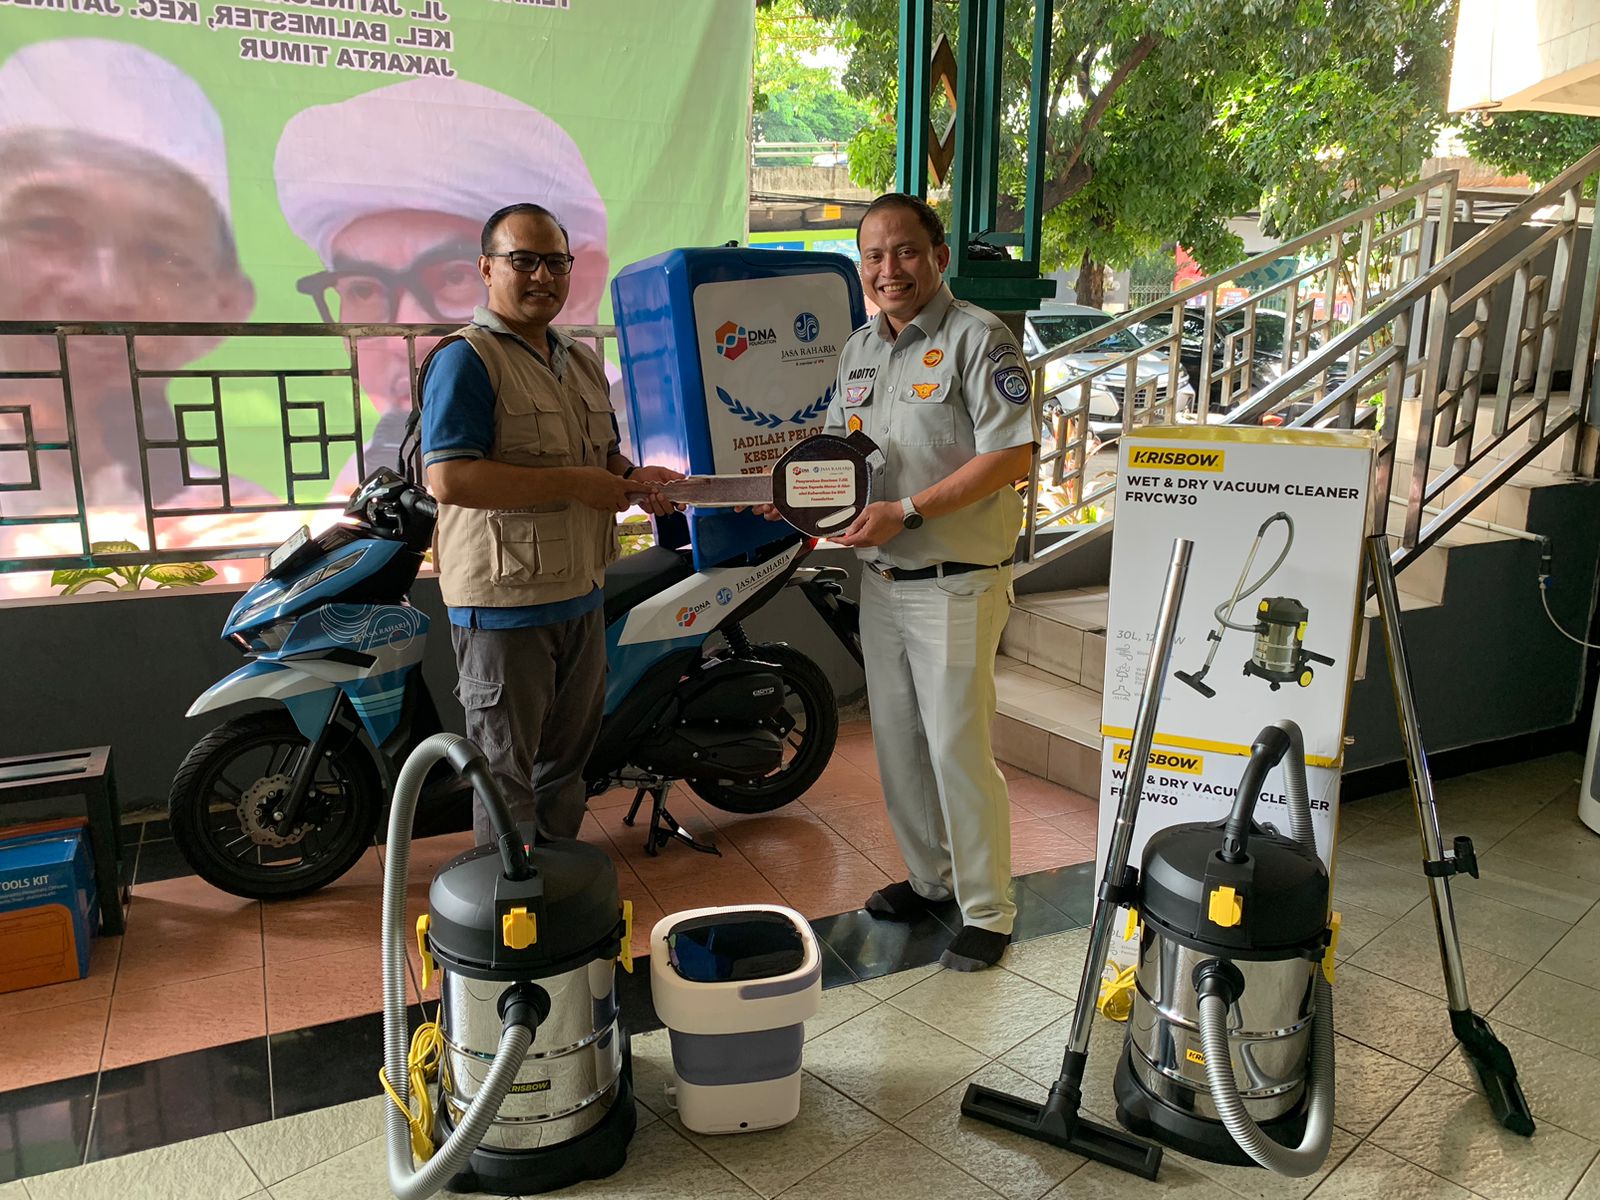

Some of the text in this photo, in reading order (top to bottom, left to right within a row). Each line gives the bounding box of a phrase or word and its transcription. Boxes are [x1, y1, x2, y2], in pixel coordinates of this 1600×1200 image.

[748, 328, 777, 341] DNA
[781, 345, 837, 360] JASA RAHARJA
[733, 431, 786, 451] JADILAH
[1133, 450, 1218, 467] KRISBOW
[1126, 475, 1360, 500] WET & DRY VACUUM CLEANER
[1125, 491, 1198, 506] FRVCW30
[735, 575, 756, 592] JASA
[755, 554, 790, 579] RAHARJA
[693, 600, 711, 613] DNA
[1146, 775, 1156, 785] &
[1159, 777, 1189, 790] DRY
[33, 875, 49, 886] KIT
[511, 1082, 549, 1092] RISBOW
